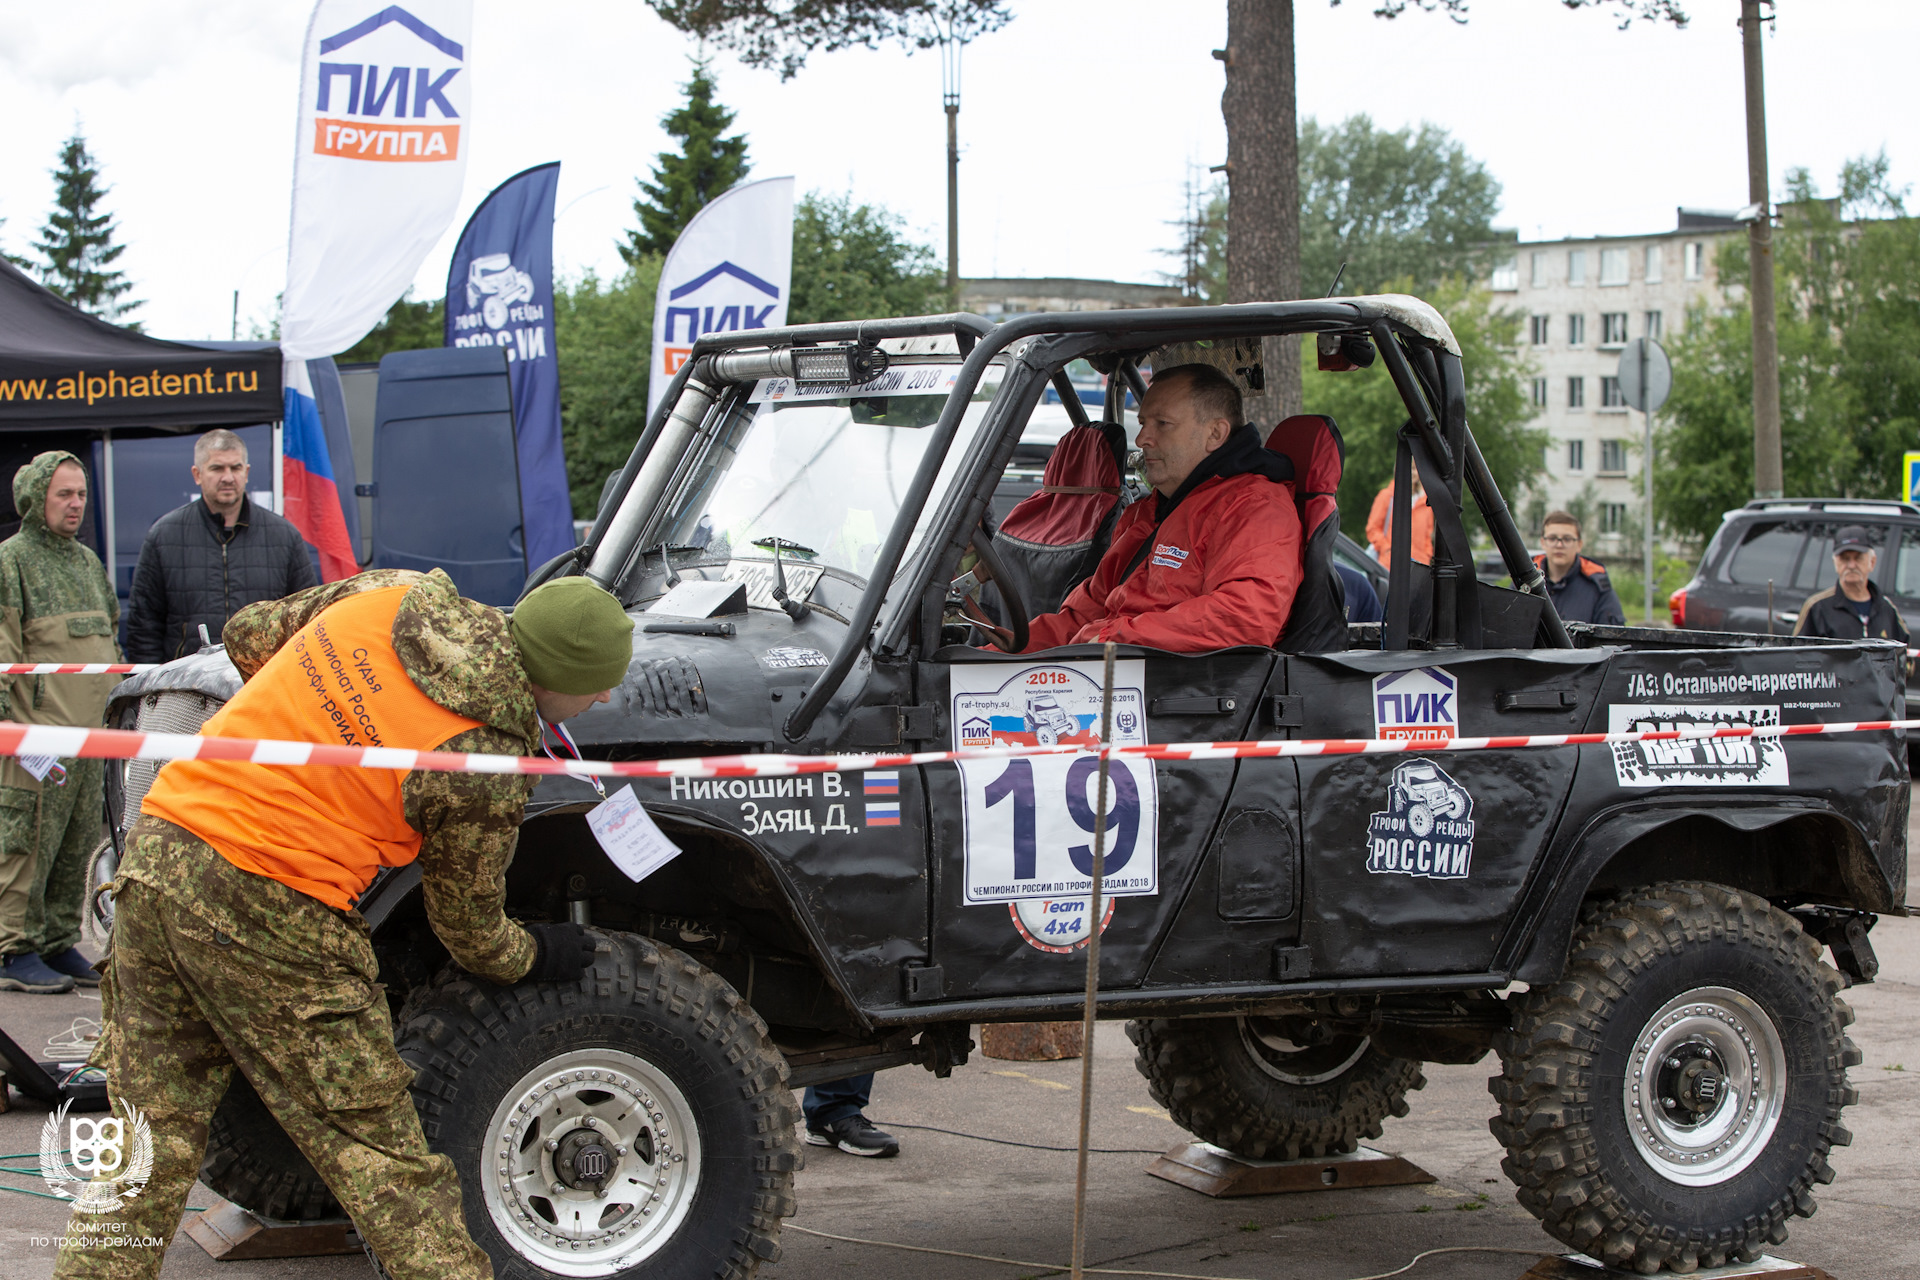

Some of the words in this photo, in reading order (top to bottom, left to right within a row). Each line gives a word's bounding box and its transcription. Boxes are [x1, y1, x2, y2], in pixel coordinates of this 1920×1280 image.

[316, 62, 463, 118] ПИК
[325, 125, 448, 156] ГРУППА
[664, 305, 777, 344] ПИК
[907, 369, 942, 390] 2018
[314, 619, 354, 693] Чемпионат
[771, 659, 827, 668] РОССИИ
[352, 648, 383, 694] Судья
[961, 701, 1010, 709] raf-trophy.su
[1377, 693, 1454, 723] ПИК
[1783, 700, 1840, 710] uaz-torgmash.ru
[962, 727, 989, 738] ПИК
[1386, 729, 1449, 740] ГРУППА
[1636, 721, 1757, 764] RAPTOR
[670, 775, 813, 800] Никошин
[823, 771, 850, 797] В.
[821, 803, 859, 835] Д.
[984, 755, 1141, 880] 19
[1374, 816, 1406, 832] ТРОФИ
[1436, 820, 1471, 838] РЕЙДЫ
[1374, 838, 1468, 876] РОССИИ
[973, 884, 1021, 896] ЧЕМПИОНАТ
[1022, 882, 1052, 893] РОССИИ
[1054, 882, 1064, 891] ПО
[1066, 878, 1128, 891] ТРОФИ-ЕЙДАМ
[1130, 878, 1149, 887] 2018
[1043, 901, 1084, 914] Team
[1044, 917, 1082, 935] 4x4
[538, 1013, 715, 1081] SILVERSTONE
